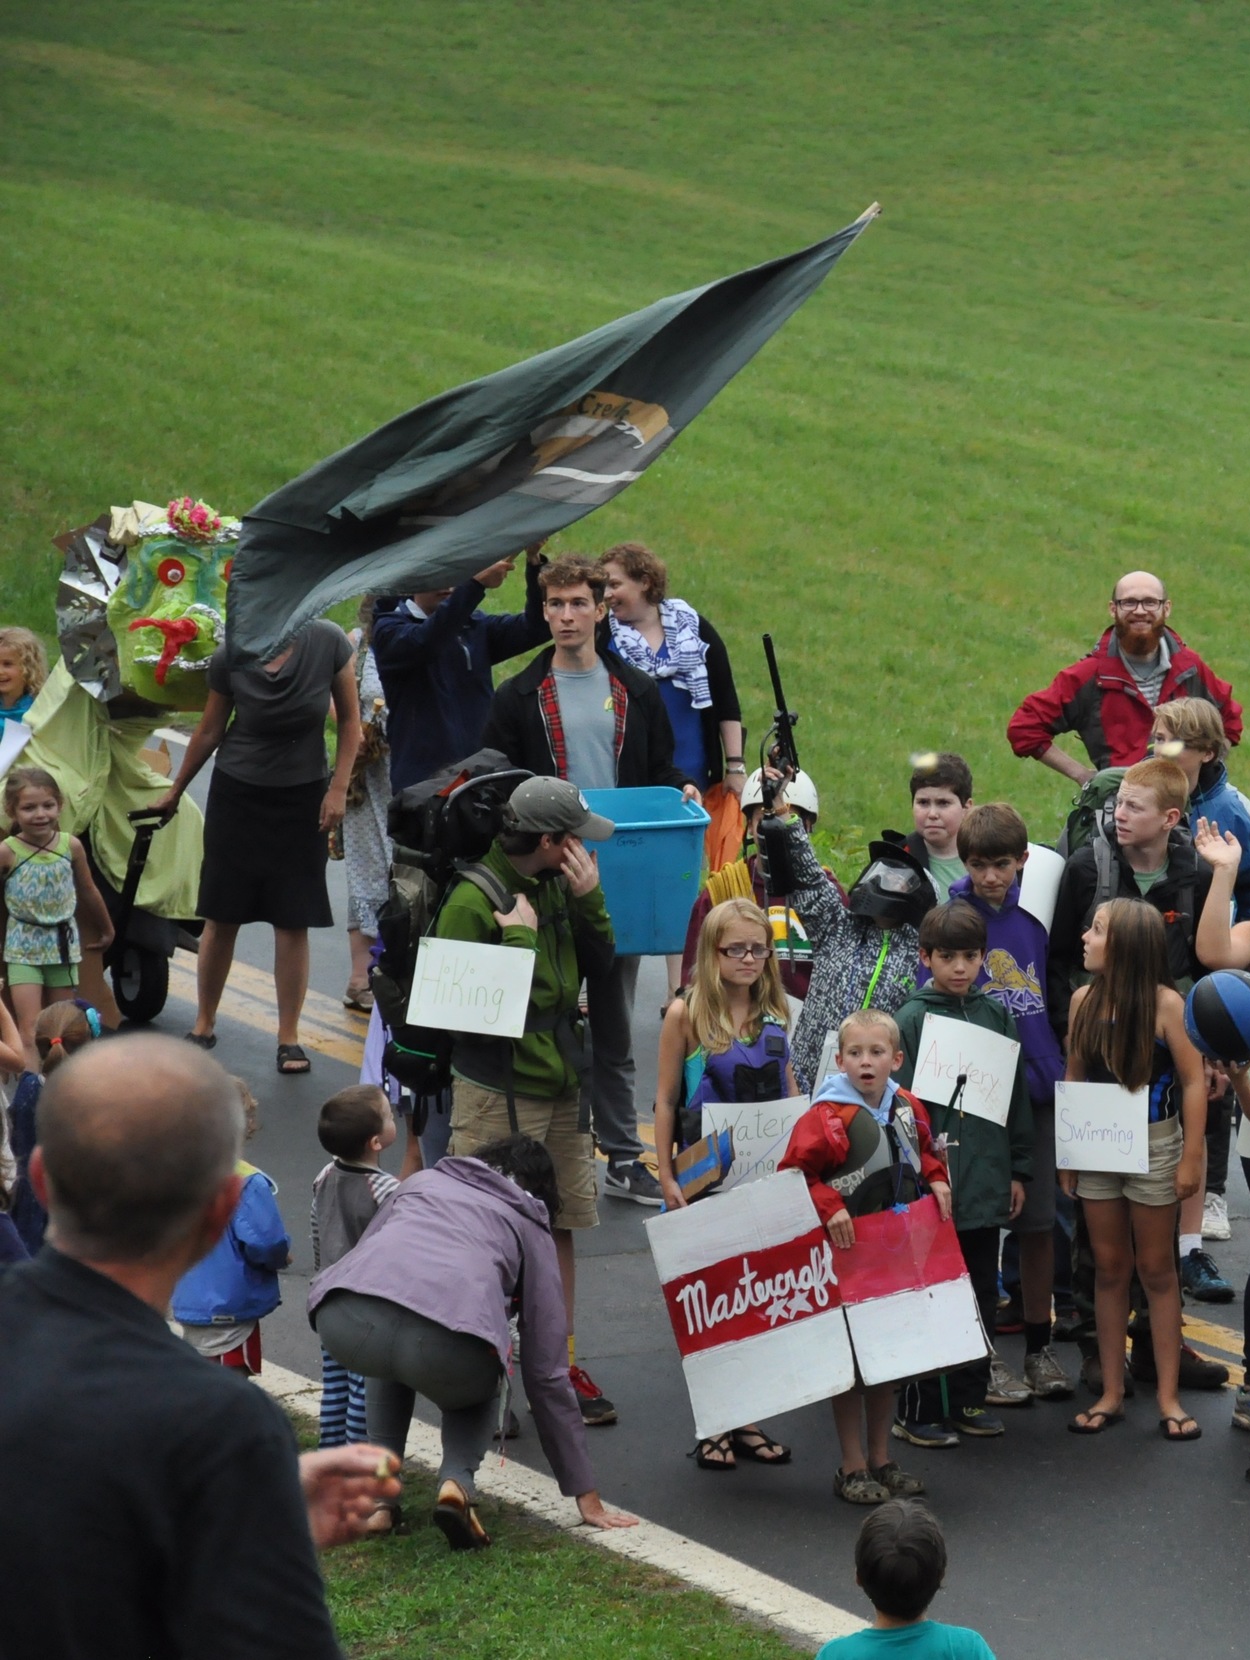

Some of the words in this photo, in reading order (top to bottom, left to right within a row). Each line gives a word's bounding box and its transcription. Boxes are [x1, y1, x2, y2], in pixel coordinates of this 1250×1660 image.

[577, 393, 632, 420] Crek
[417, 952, 504, 1025] Hiking
[918, 1039, 1000, 1102] Archery
[708, 1109, 792, 1142] Water
[1057, 1107, 1134, 1155] Swimming
[832, 1166, 866, 1191] BODY
